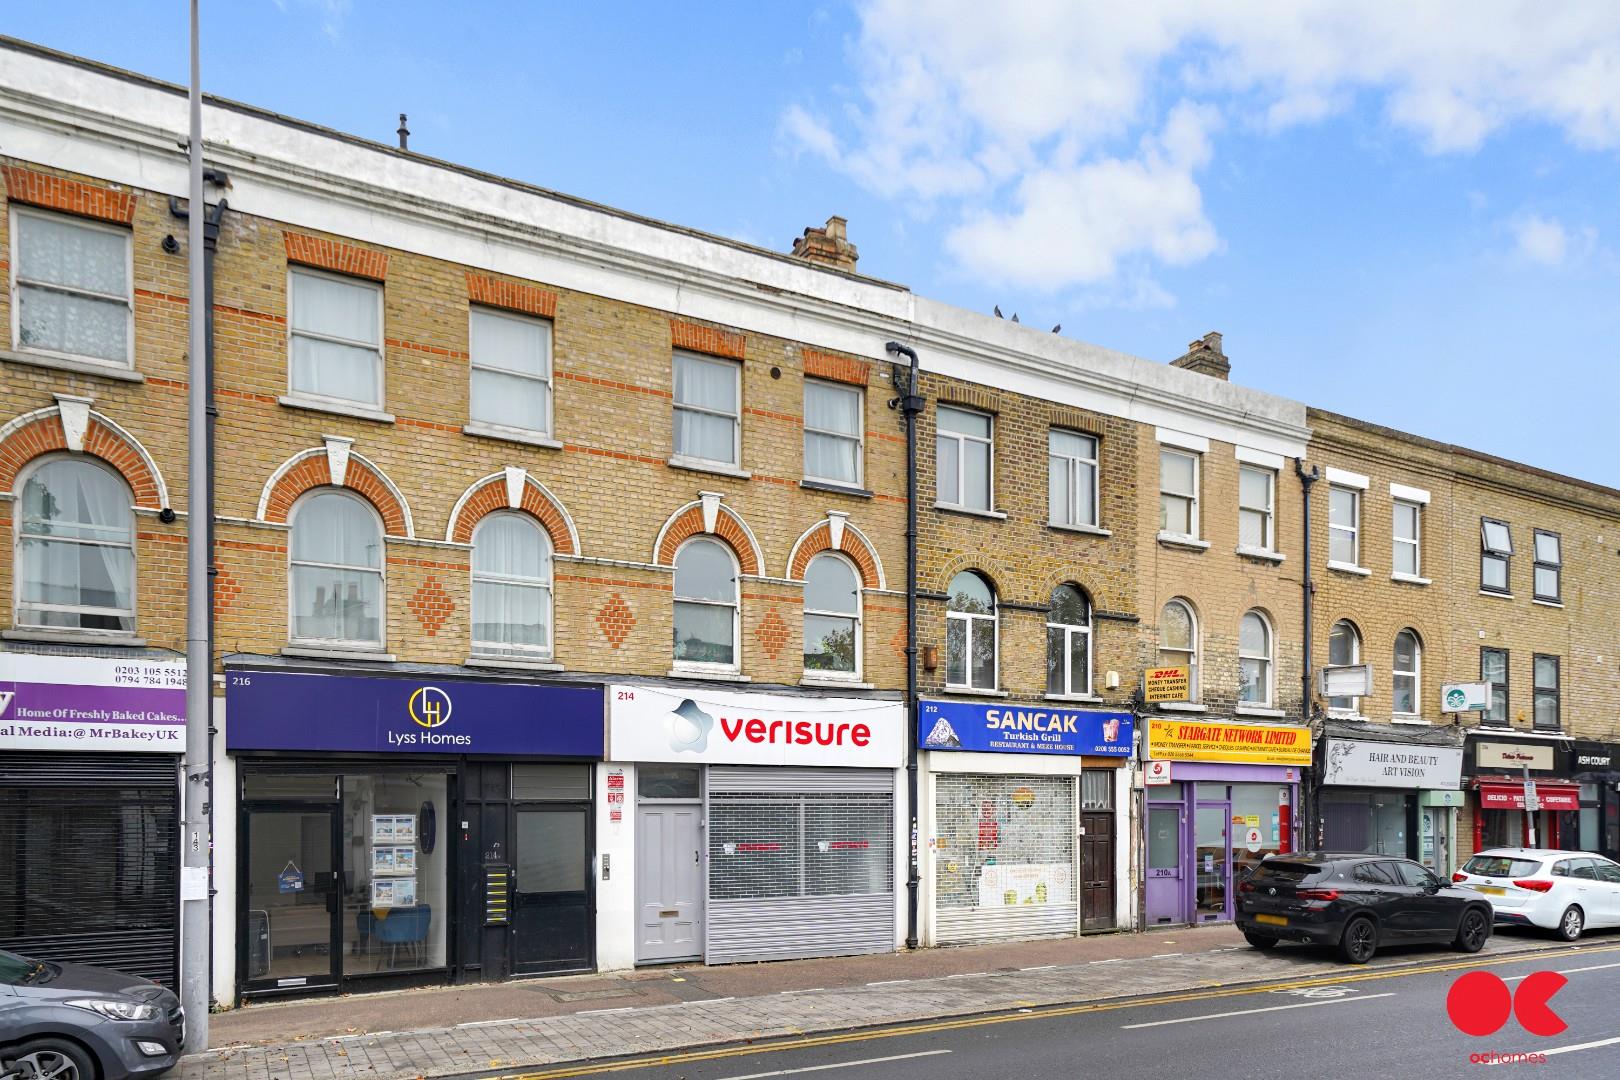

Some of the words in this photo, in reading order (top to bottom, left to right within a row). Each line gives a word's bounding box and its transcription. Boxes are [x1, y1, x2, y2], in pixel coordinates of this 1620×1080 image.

[115, 666, 140, 675] 0203
[144, 668, 161, 676] 105
[115, 676, 140, 684] 0794
[232, 677, 251, 686] 216
[617, 691, 634, 701] 214
[17, 708, 52, 718] Home
[53, 709, 68, 718] Of
[69, 710, 110, 721] Freshly
[112, 711, 145, 721] Baked
[925, 705, 938, 713] 212
[986, 709, 1078, 733] SANCAK
[388, 731, 416, 746] Lyss
[420, 732, 471, 745] Homes
[1003, 731, 1039, 741] Turkish
[1041, 732, 1062, 742] Grill
[1178, 726, 1222, 742] STARGATE
[1223, 728, 1264, 744] NETWORK
[1264, 731, 1297, 746] LIMITED
[990, 740, 1030, 749] RESTAURANT
[1054, 743, 1075, 751] HOUSE
[1368, 752, 1389, 762] HAIR
[1390, 754, 1406, 764] AND
[1407, 755, 1440, 766] BEAUTY
[1577, 756, 1591, 765] ASH
[1590, 756, 1611, 766] COURT
[1381, 766, 1398, 777] ART
[1399, 767, 1426, 778] VISION
